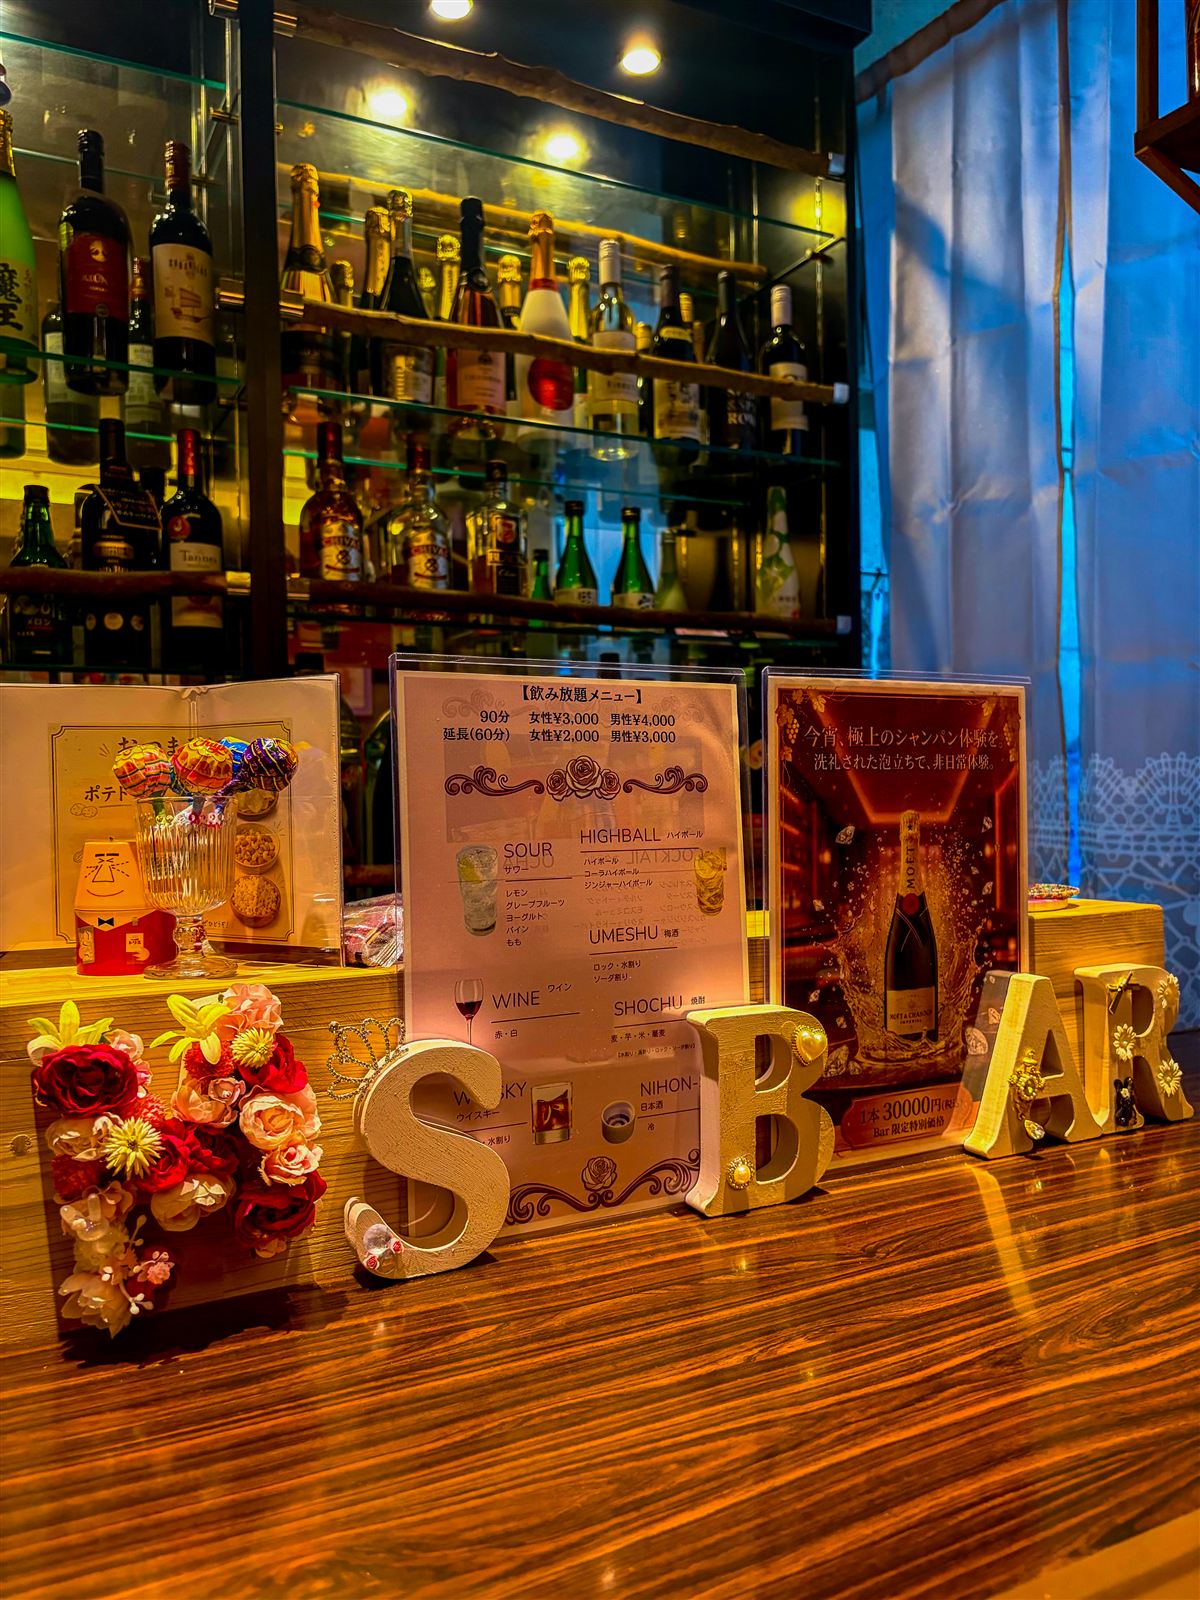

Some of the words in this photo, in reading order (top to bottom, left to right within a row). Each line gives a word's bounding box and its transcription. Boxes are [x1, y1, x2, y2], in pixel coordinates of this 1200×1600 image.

[522, 685, 642, 704] 【飲み放題メニュー】
[480, 710, 510, 724] 90分
[529, 711, 599, 726] 女性¥3,000
[610, 713, 676, 727] 男性¥4,000
[443, 727, 510, 742] 延長(60分)
[529, 729, 600, 743] 女性¥2,000
[610, 730, 676, 744] 男性¥3,000
[804, 725, 1004, 749] 今宵、極上のシャンパン体験を。
[813, 753, 995, 771] 洗礼された泡立ちで、非日常体験。
[580, 828, 661, 844] HIGHBALL
[503, 842, 553, 859] SOUR
[504, 866, 529, 875] サワー
[506, 889, 528, 898] レモン
[506, 899, 565, 910] グレープフルーツ
[506, 912, 543, 923] ヨーグルト
[506, 926, 529, 935] パイン
[589, 925, 658, 944] UMESHU
[664, 928, 679, 938] 梅酒
[506, 938, 522, 947] もも
[593, 960, 641, 972] ロック・水割り
[593, 973, 628, 984] ソーダ割り
[492, 990, 540, 1010] WINE
[547, 983, 572, 993] ワイン
[614, 996, 684, 1016] SHOCHU
[690, 996, 705, 1006] 焼酎
[495, 1029, 518, 1040] 赤・白
[640, 1100, 664, 1112] 日本酒
[456, 1109, 500, 1123] ウイスキー
[873, 1127, 890, 1138] Bar
[892, 1115, 946, 1136] 限定特別価格
[344, 1039, 511, 1280] S
